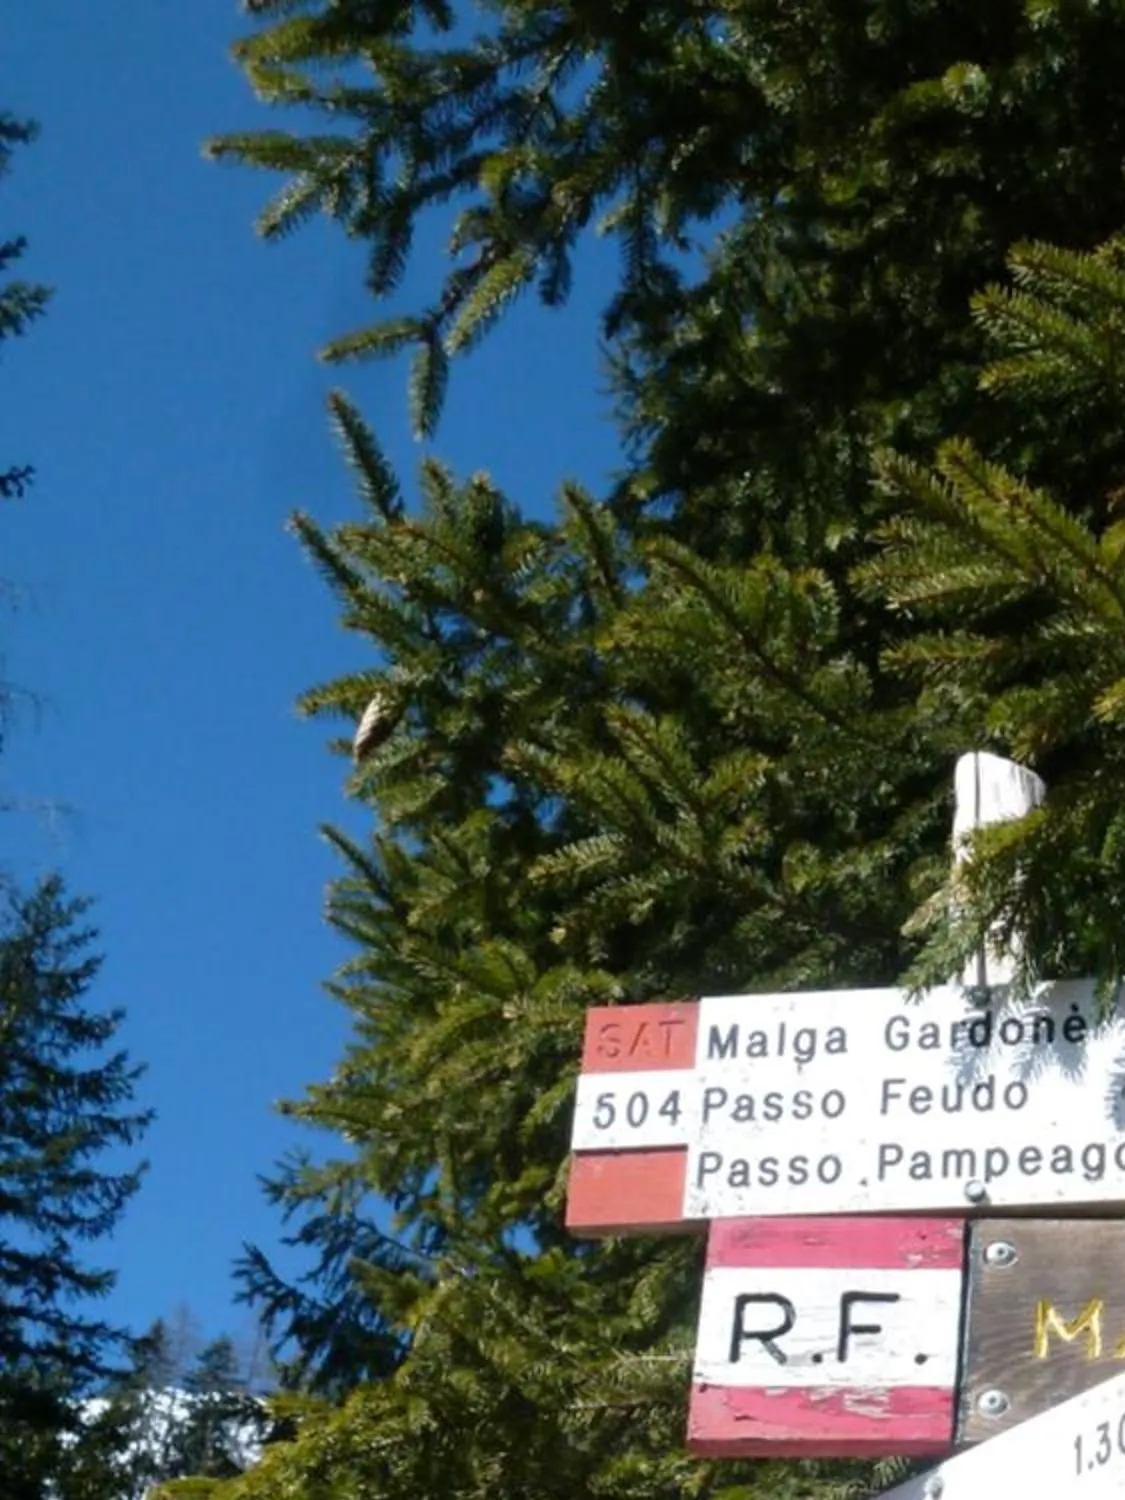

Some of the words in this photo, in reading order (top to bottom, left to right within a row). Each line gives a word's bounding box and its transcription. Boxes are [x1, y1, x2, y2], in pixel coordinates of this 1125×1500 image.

[708, 1021, 849, 1064] Malga
[884, 1003, 1088, 1051] Gardonè
[592, 1090, 683, 1131] 504
[702, 1086, 846, 1124] Passo
[879, 1074, 1029, 1116] Feudo
[696, 1151, 843, 1189] Passo
[728, 1291, 929, 1365] R.F.
